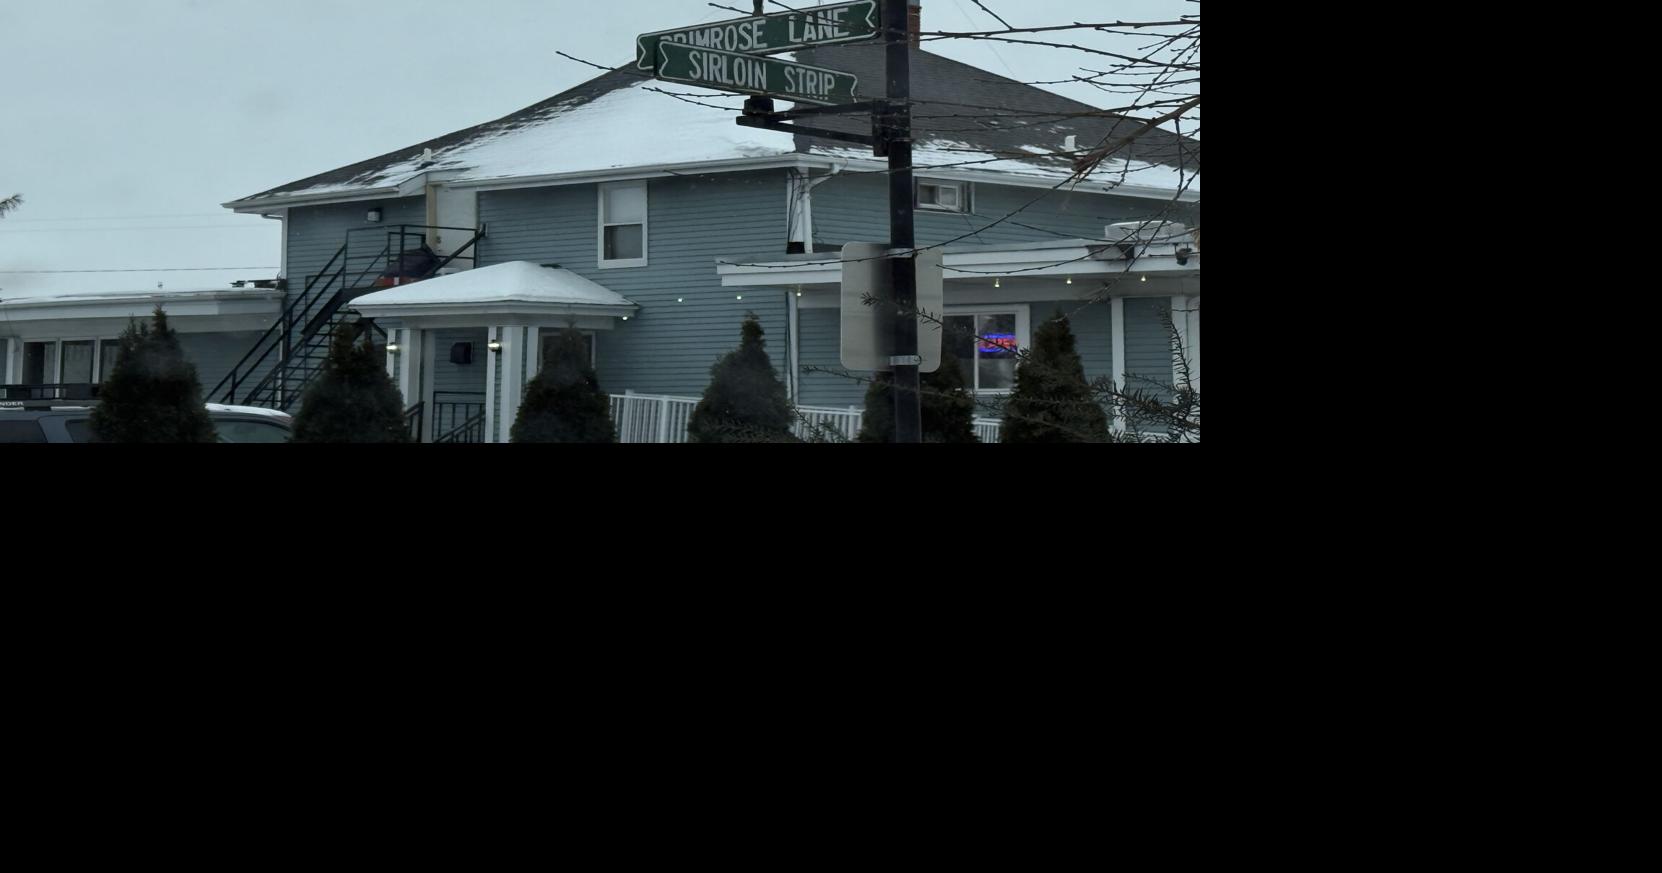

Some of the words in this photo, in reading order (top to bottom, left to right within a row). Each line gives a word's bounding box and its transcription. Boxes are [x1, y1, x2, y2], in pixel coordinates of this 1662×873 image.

[660, 20, 768, 51] IMROSE
[788, 8, 850, 43] LANE
[689, 51, 767, 90] SIRLOIN
[783, 66, 835, 95] STRIP
